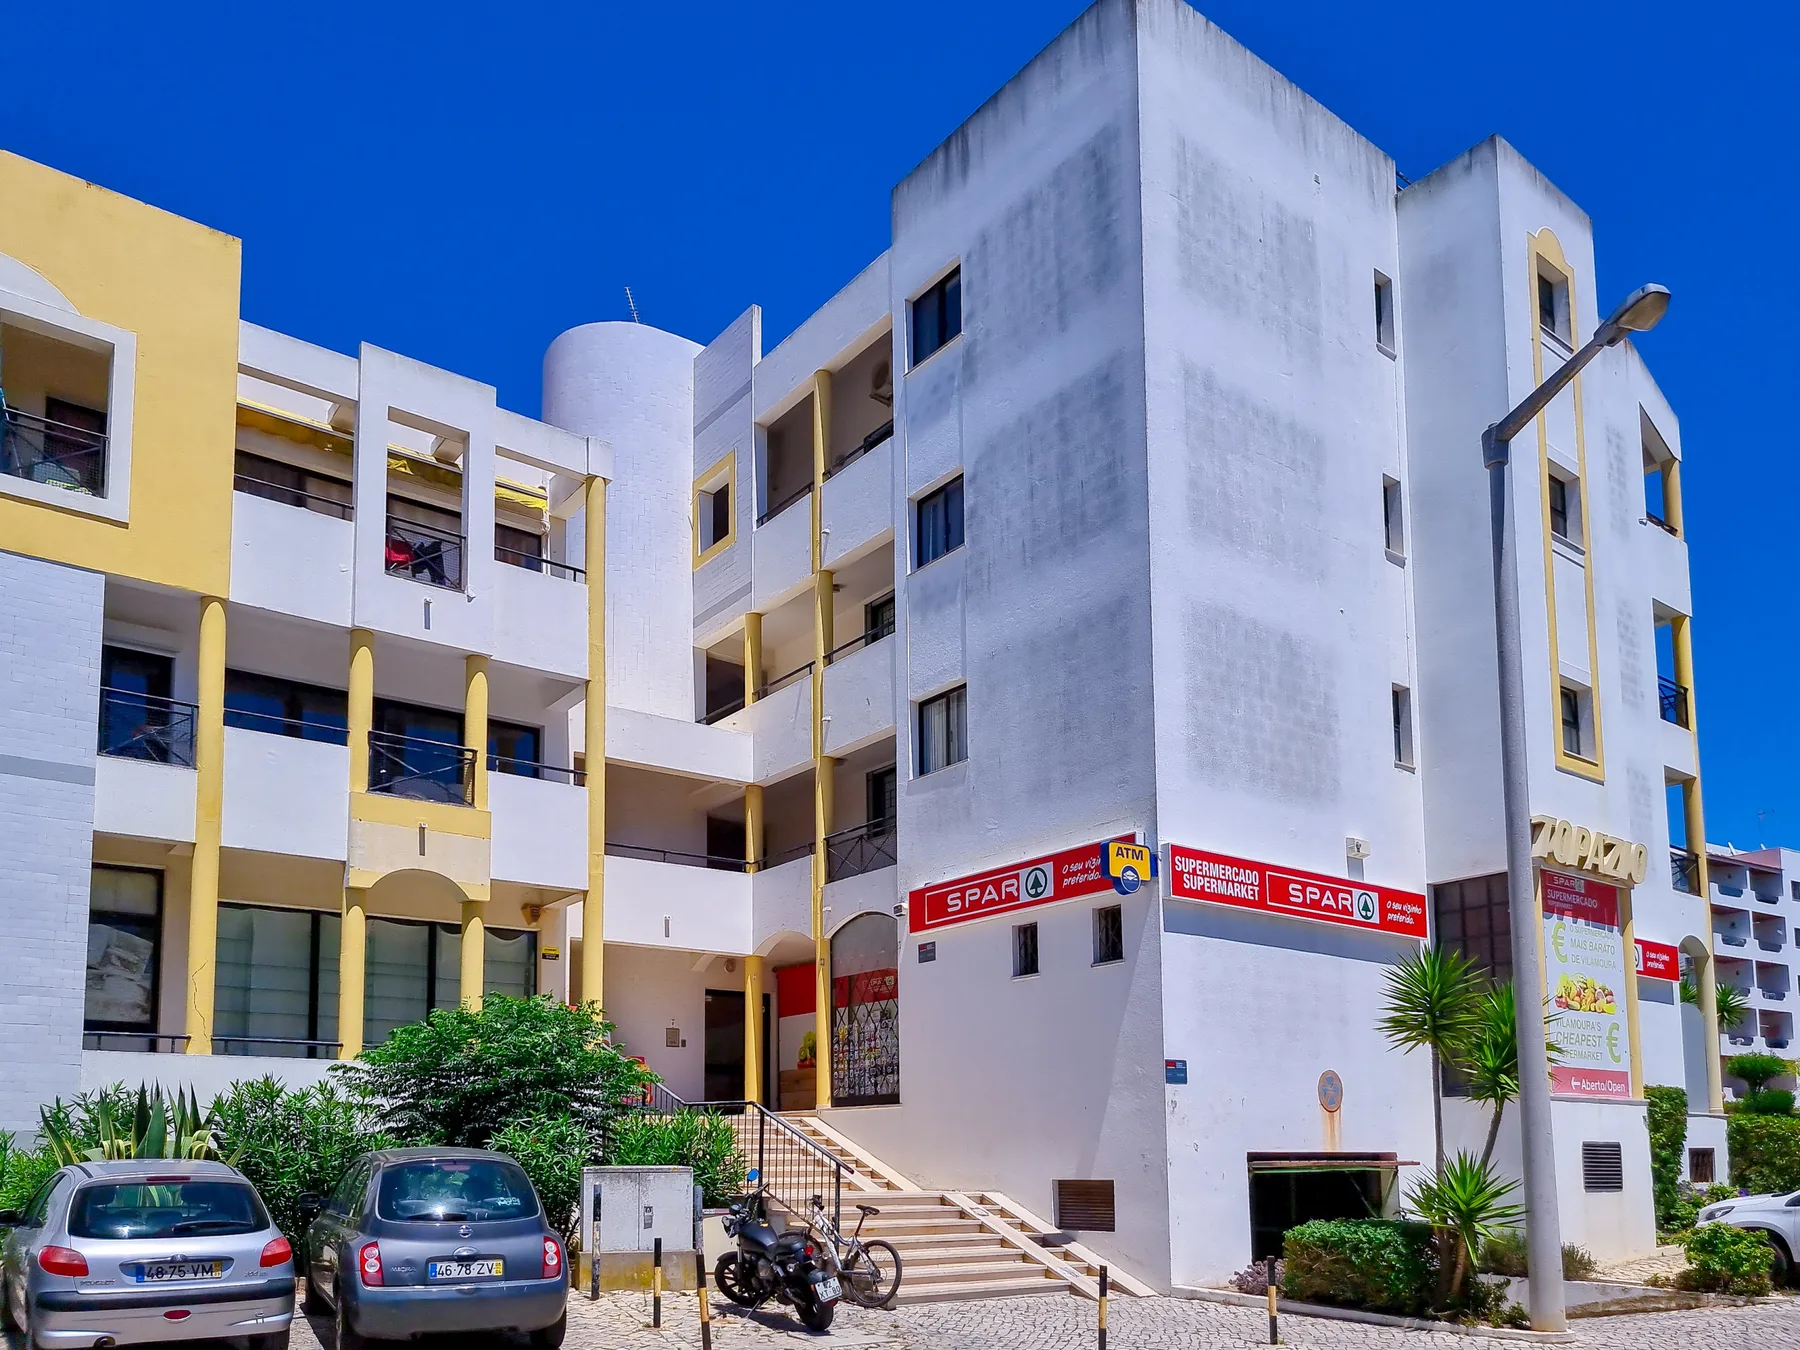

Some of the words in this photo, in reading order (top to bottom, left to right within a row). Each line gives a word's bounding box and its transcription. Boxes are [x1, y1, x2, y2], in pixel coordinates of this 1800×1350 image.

[1116, 846, 1143, 861] ATM
[1531, 814, 1648, 884] TOPAZIO
[1062, 865, 1069, 874] O
[1069, 862, 1083, 872] seu
[1175, 855, 1259, 886] SUPERMERCADO
[1062, 869, 1101, 888] preferido.
[1183, 872, 1259, 901] SUPERMARKET
[1553, 877, 1574, 886] SPAR
[947, 878, 1018, 912] SPAR
[1288, 883, 1352, 912] SPAR
[1547, 889, 1598, 908] SUPERMERCADO
[1392, 902, 1402, 910] seu
[1575, 926, 1614, 940] SUPERMERCADO
[1570, 938, 1588, 950] MAIS
[1589, 941, 1615, 955] BARATO
[1571, 954, 1580, 964] DE
[1581, 956, 1616, 970] VILAMOURA
[1556, 1017, 1602, 1031] VILAMOURA'S
[1556, 1032, 1602, 1047] CHEAPEST
[1581, 1079, 1625, 1093] Aberto/Open
